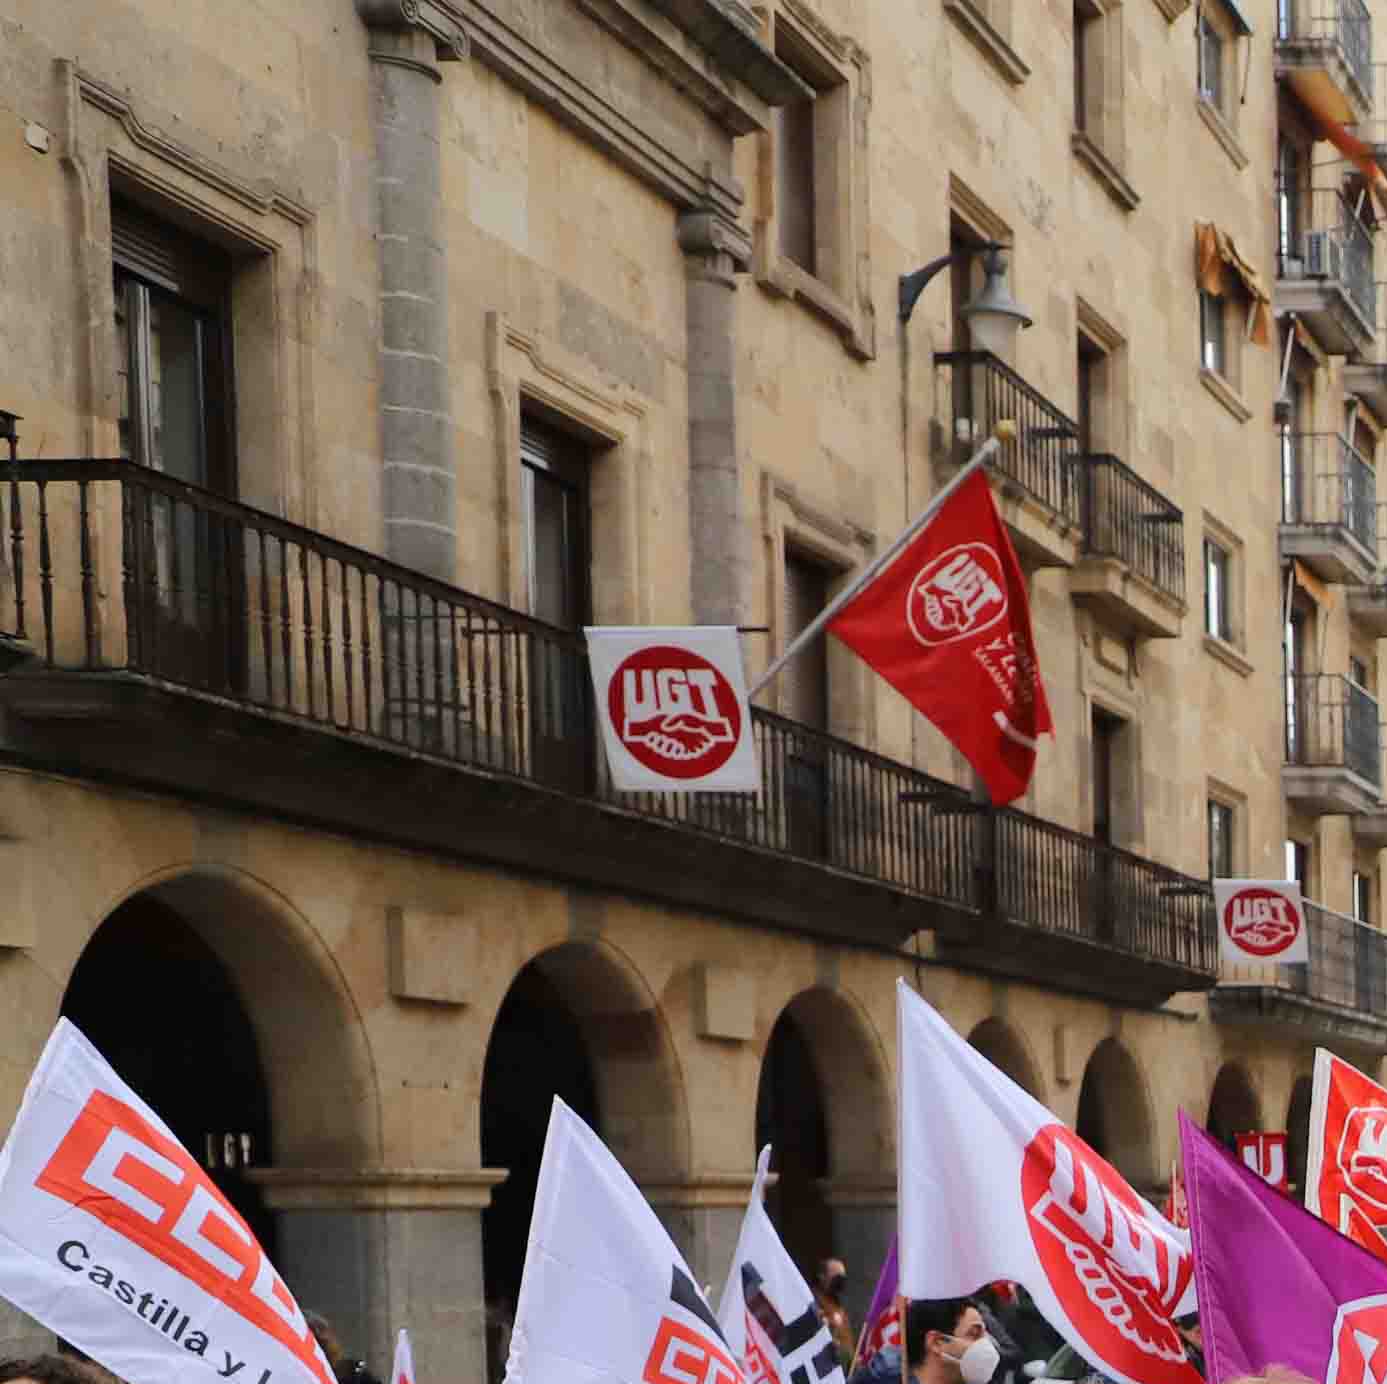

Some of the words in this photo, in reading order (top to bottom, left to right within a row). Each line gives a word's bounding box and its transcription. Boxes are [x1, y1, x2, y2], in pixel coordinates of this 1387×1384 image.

[931, 552, 1004, 615] UGT
[623, 669, 721, 724] UGT
[1232, 896, 1288, 928] UGT
[57, 1240, 210, 1356] Castilla
[217, 1351, 247, 1378] y
